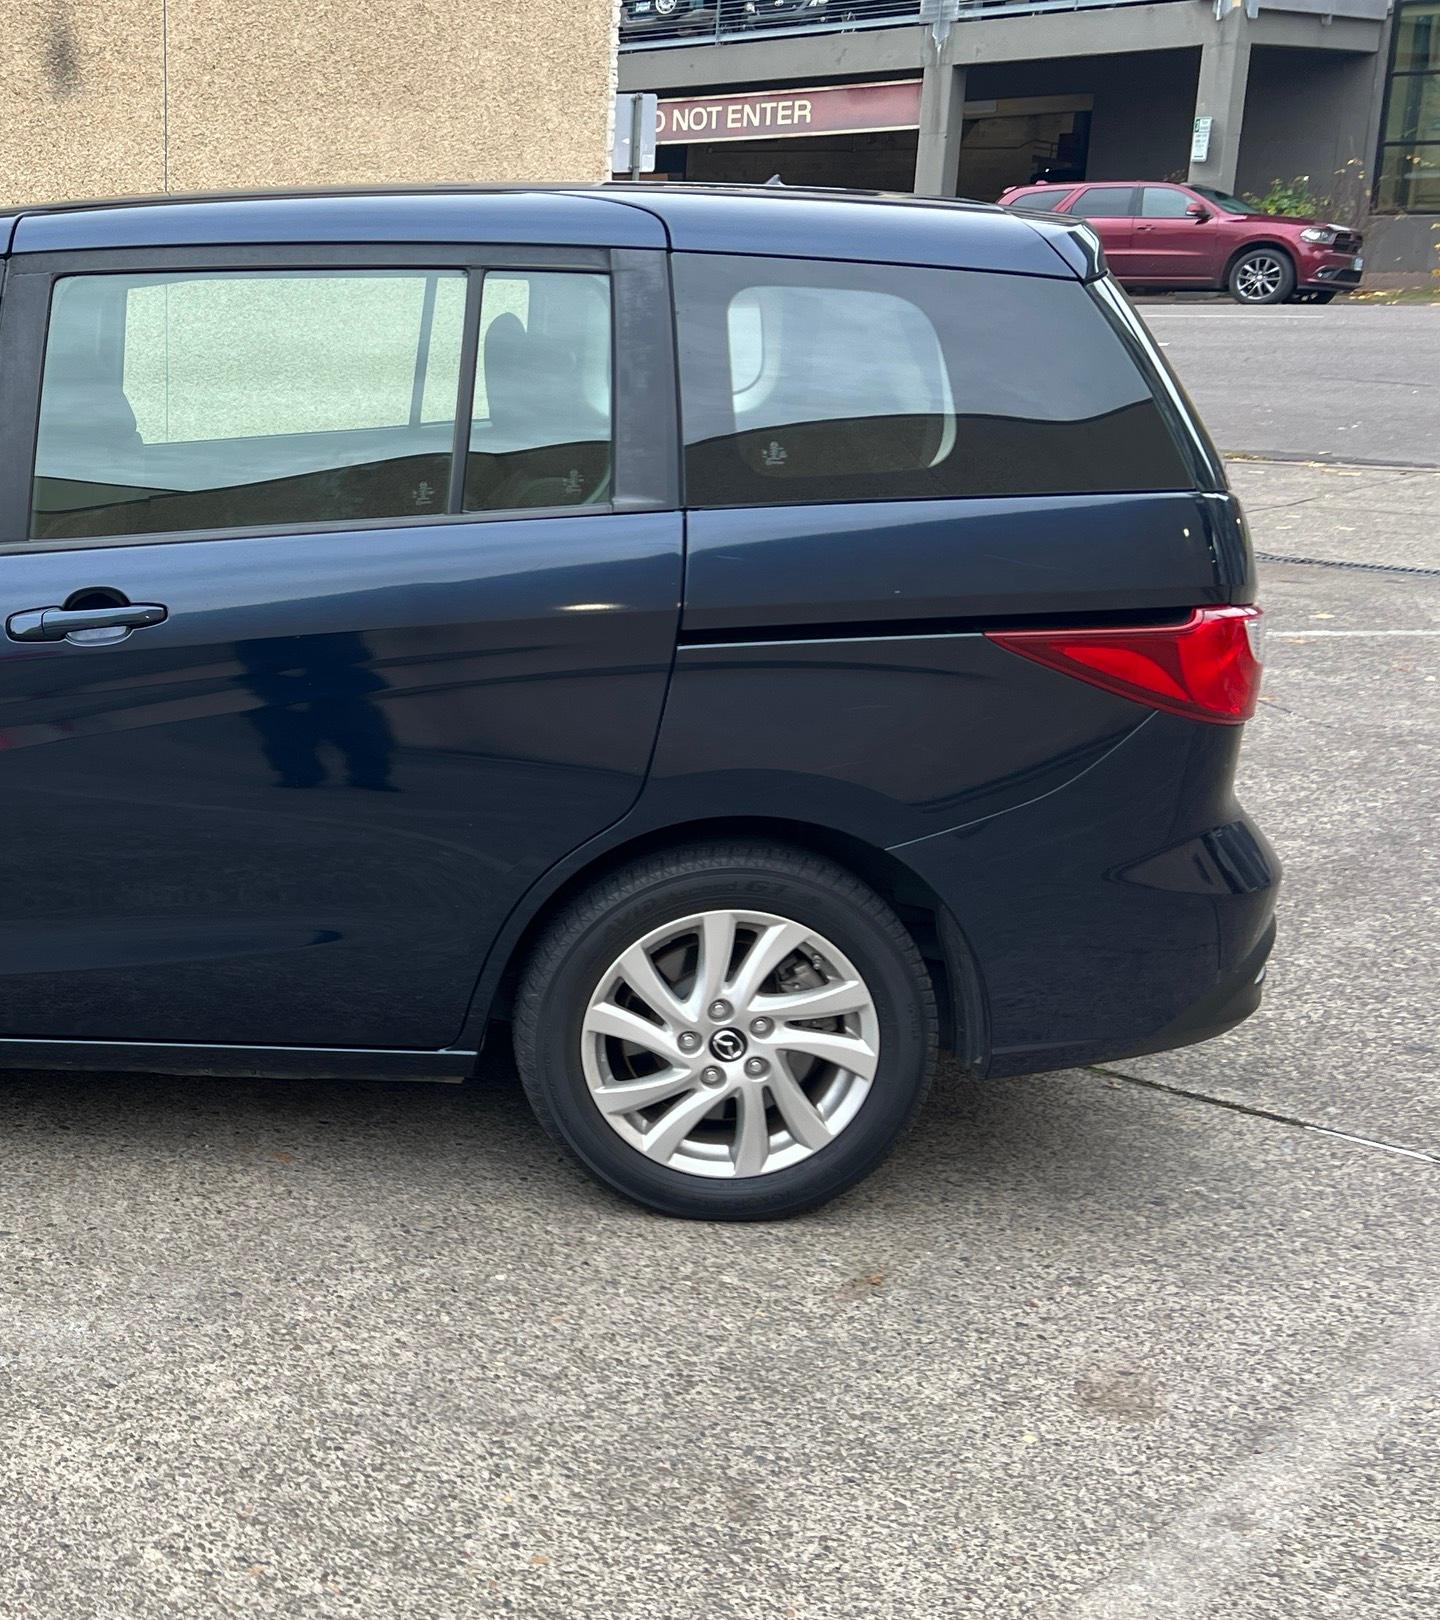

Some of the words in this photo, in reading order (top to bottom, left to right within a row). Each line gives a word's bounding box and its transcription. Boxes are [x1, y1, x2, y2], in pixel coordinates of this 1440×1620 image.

[655, 110, 666, 133] O
[672, 105, 723, 132] NOT
[726, 99, 812, 129] ENTER
